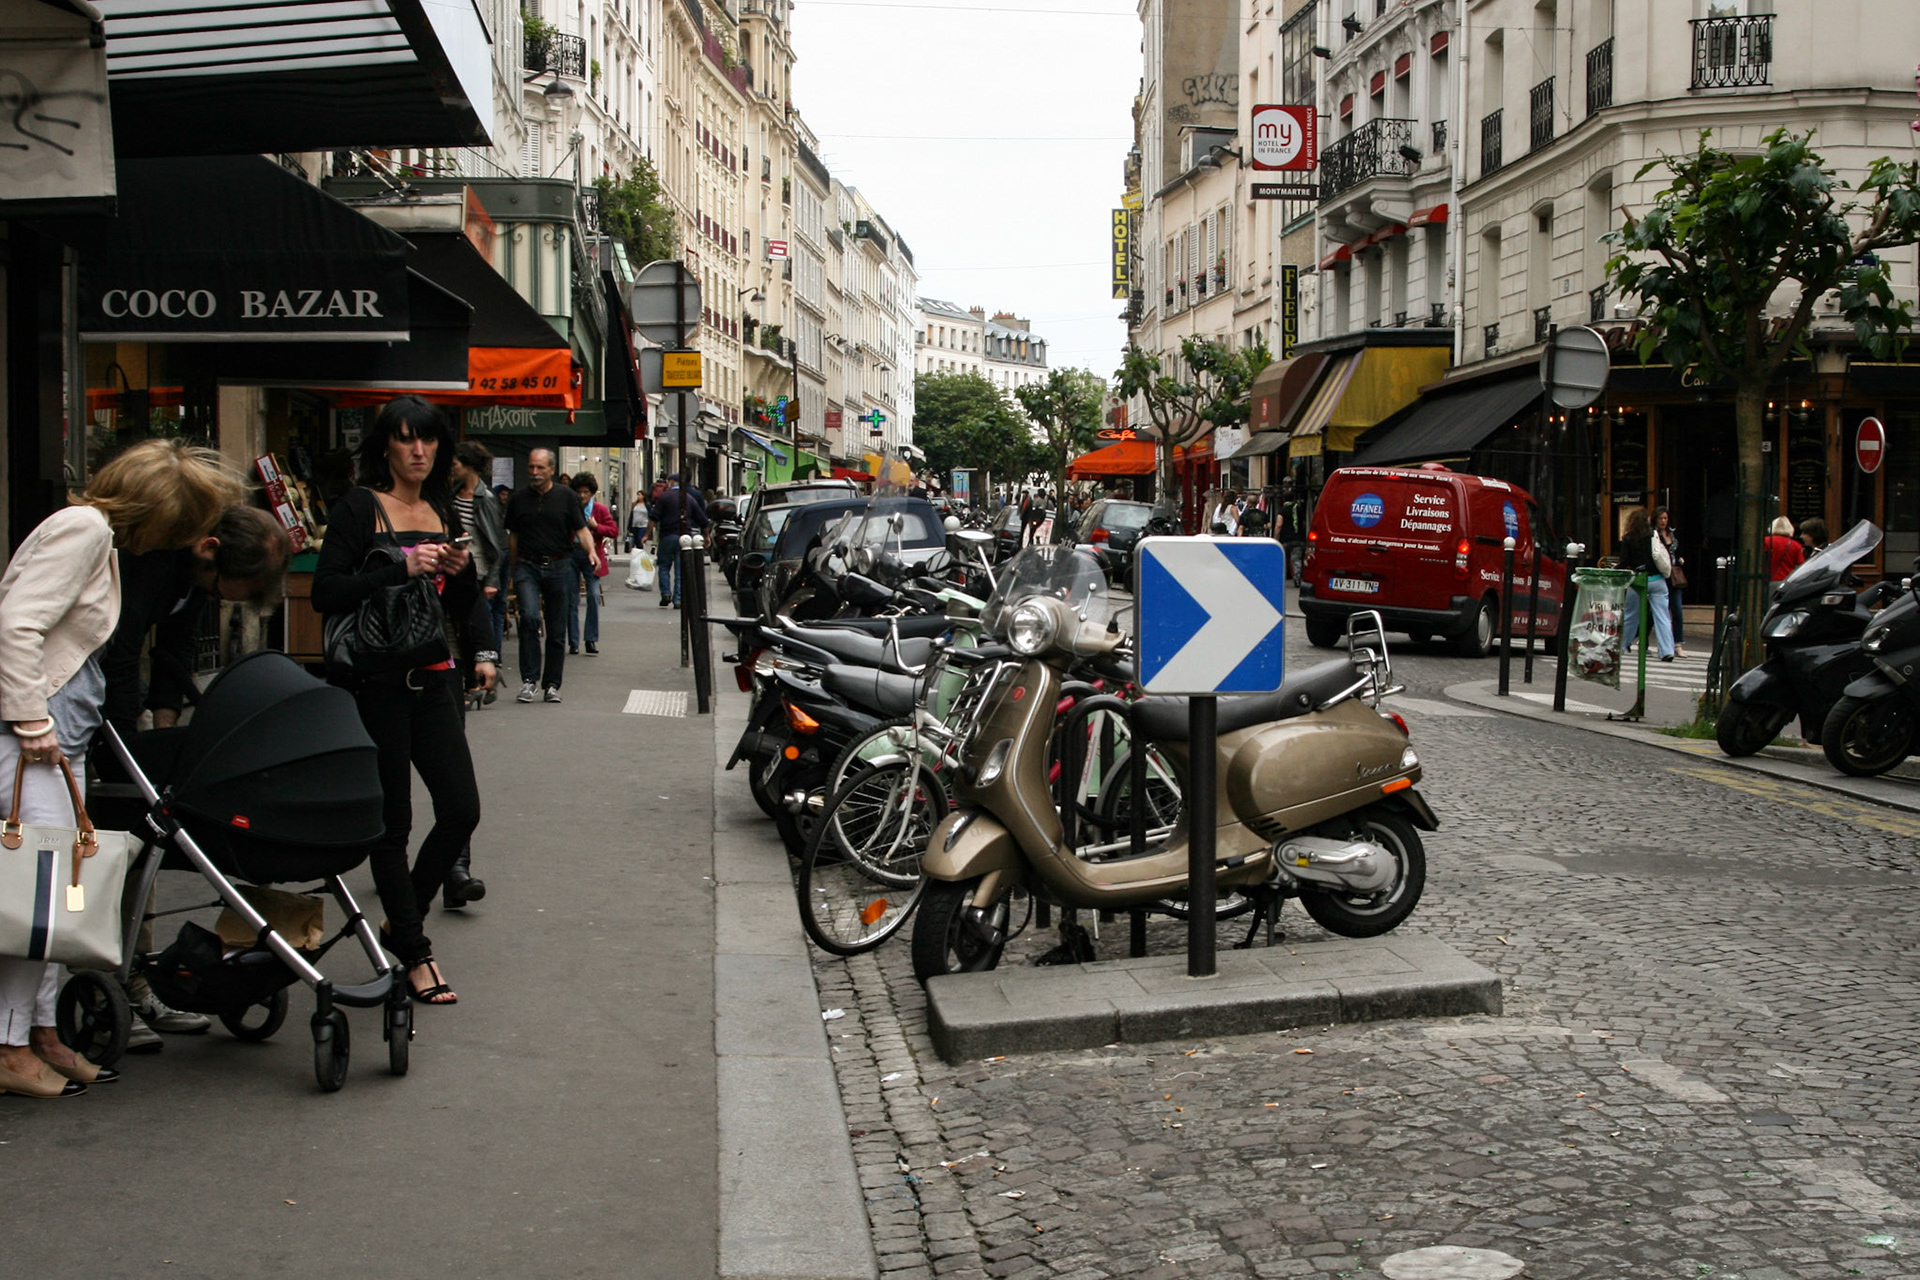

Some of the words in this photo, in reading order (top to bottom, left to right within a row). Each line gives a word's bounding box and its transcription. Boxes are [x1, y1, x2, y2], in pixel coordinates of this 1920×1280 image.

[1258, 123, 1291, 147] my
[1306, 130, 1313, 138] IN
[1259, 187, 1311, 195] MONTMARTRE
[1113, 210, 1128, 279] HOTEL
[101, 289, 217, 318] COCO
[240, 289, 384, 318] BAZAR
[1283, 268, 1296, 360] FLEURS
[480, 377, 497, 390] 42
[500, 377, 518, 390] 58
[521, 376, 539, 389] 45
[542, 375, 558, 388] 01
[467, 408, 480, 428] LA
[480, 404, 537, 431] MASCOTTE
[1097, 429, 1137, 441] Café
[1413, 493, 1446, 505] Service
[1351, 503, 1383, 514] TAFANEL
[1406, 506, 1450, 519] Livraisons
[1400, 518, 1452, 533] Dépannages
[1376, 539, 1403, 548] dangereux
[1404, 541, 1416, 549] pour
[1417, 541, 1423, 549] la
[1480, 569, 1500, 582] Service
